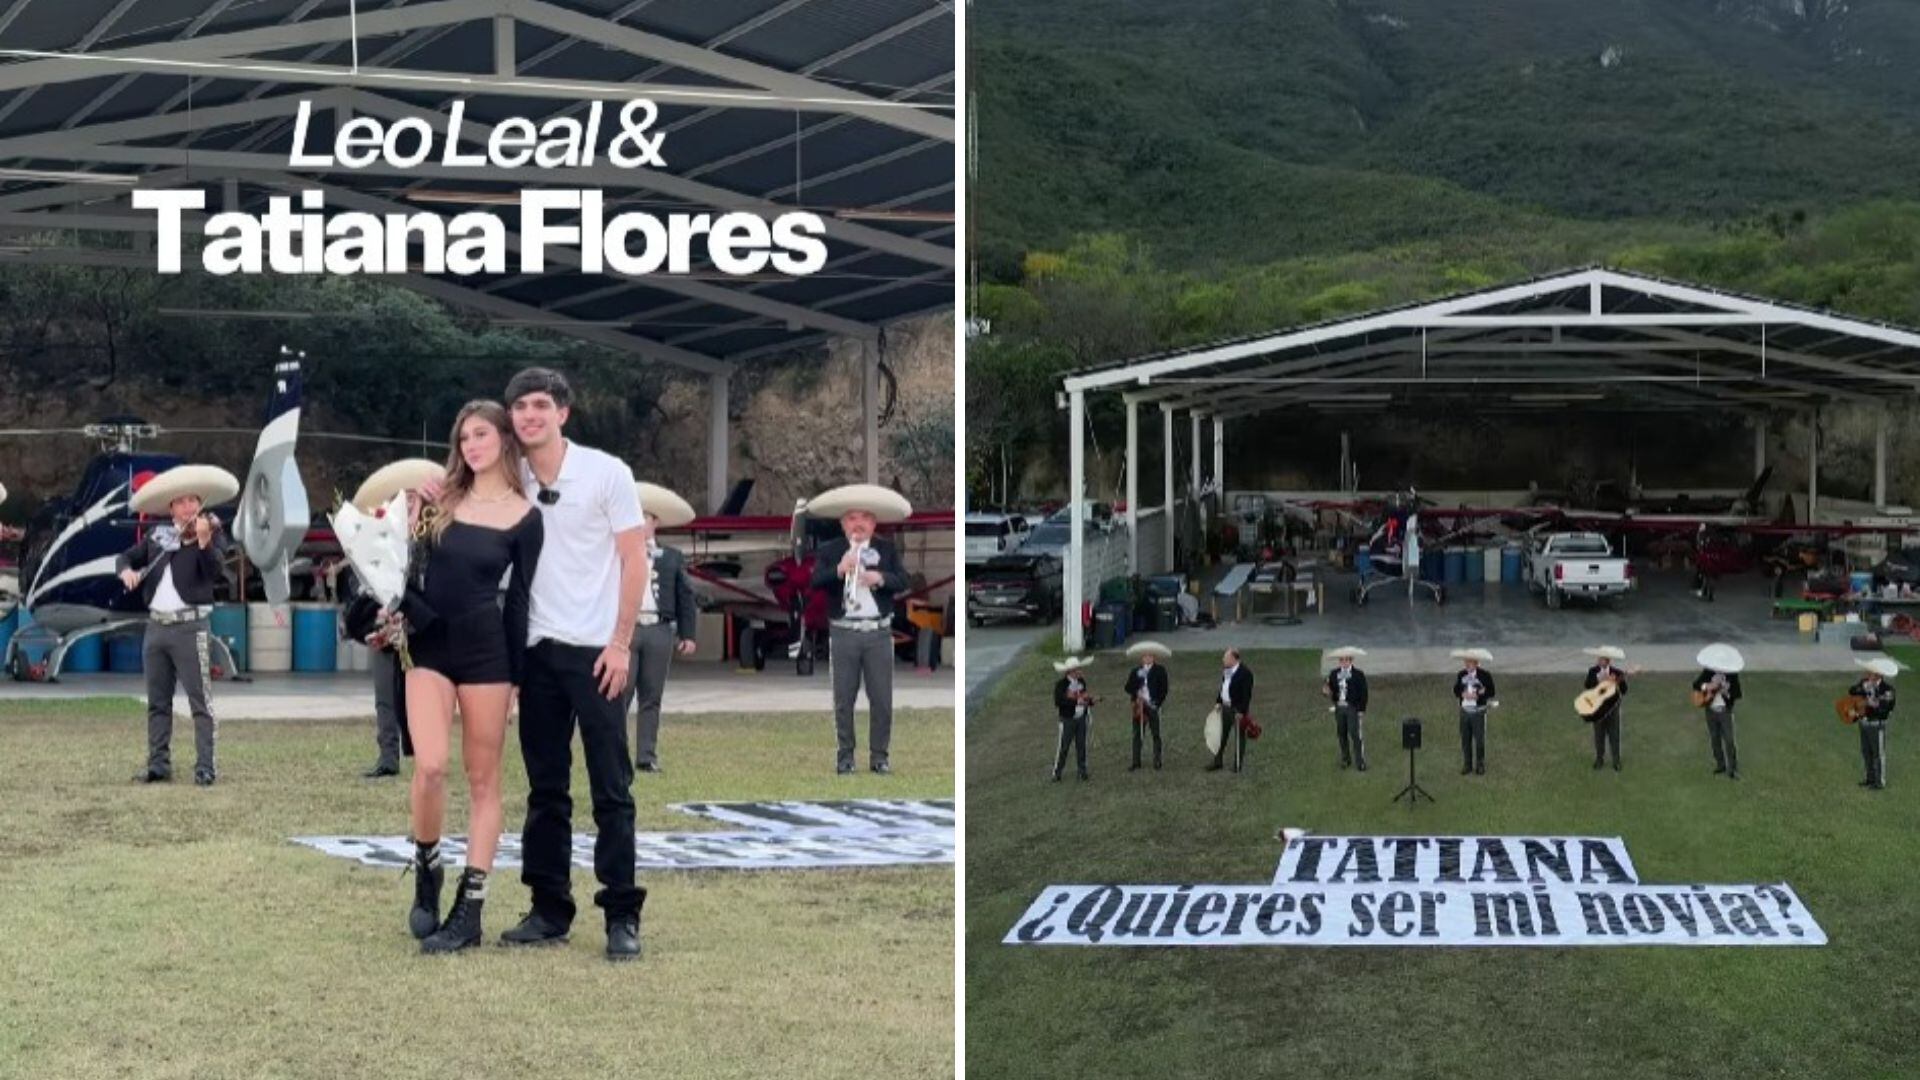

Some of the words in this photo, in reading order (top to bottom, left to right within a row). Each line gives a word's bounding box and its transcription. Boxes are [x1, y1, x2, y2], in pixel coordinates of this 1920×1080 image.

[1287, 837, 1637, 884] TATIANA
[1017, 885, 1326, 943] ¿Quieres
[1348, 889, 1447, 937] ser
[1471, 885, 1562, 937] mi
[1574, 884, 1805, 938] novia?
